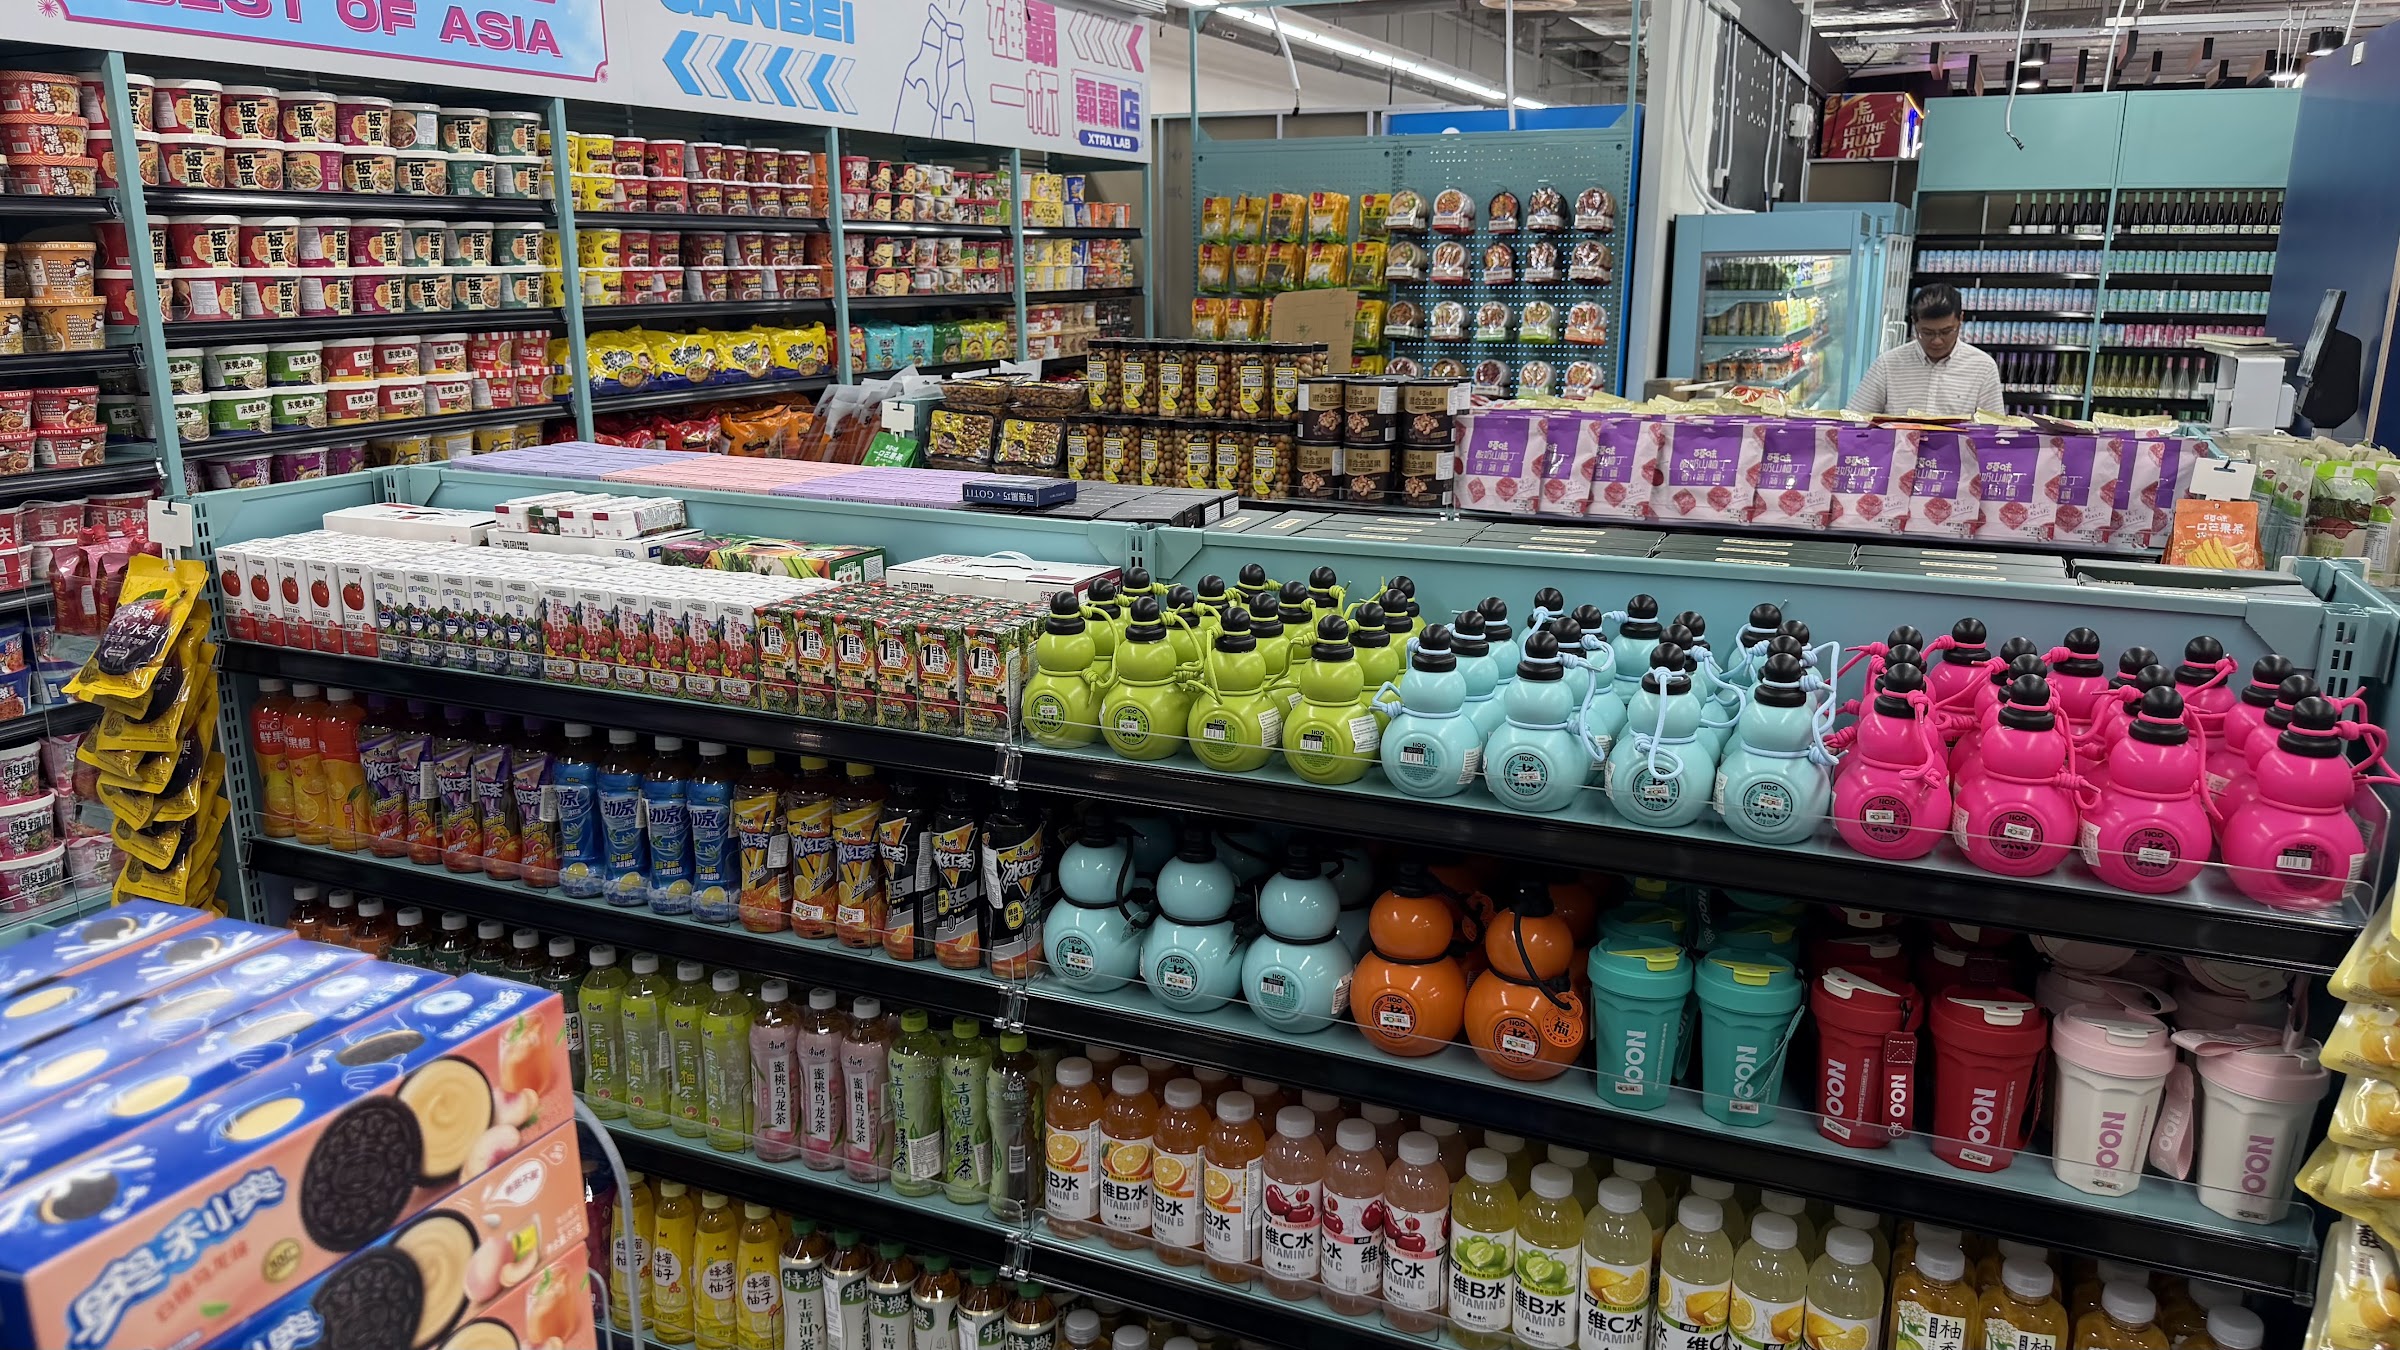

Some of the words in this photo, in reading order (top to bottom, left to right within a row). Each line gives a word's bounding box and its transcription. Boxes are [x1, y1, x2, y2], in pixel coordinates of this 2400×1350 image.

[336, 0, 415, 36] OF
[440, 5, 563, 58] ASIA
[660, 0, 855, 44] NBEI
[194, 96, 210, 130] 板面
[240, 102, 257, 134] 板面
[298, 107, 315, 138] 板面
[1857, 113, 1875, 124] HU
[368, 112, 382, 142] 板面
[457, 121, 473, 148] 板面
[1844, 126, 1866, 138] LET
[1865, 120, 1888, 132] THE
[1088, 133, 1112, 147] XTRA
[1114, 137, 1131, 150] LAB
[1842, 132, 1886, 150] HUAT
[1846, 144, 1880, 159] OUT
[186, 149, 202, 181] 板面
[236, 154, 256, 184] 板面
[357, 162, 373, 191] 板面
[410, 163, 424, 191] 板面
[211, 231, 228, 263] 板面
[266, 233, 282, 263] 板面
[385, 235, 397, 261] 板面
[279, 284, 293, 313] 板面
[421, 281, 437, 307] 板面
[467, 279, 481, 305] 板面
[965, 489, 994, 499] GOTIT
[38, 517, 80, 537] 重庆
[363, 759, 400, 781] 冰红
[794, 837, 834, 857] 冰红茶
[838, 843, 878, 863] 冰红茶
[934, 851, 973, 870] 冰红茶
[1553, 1016, 1570, 1036] 福
[773, 1060, 787, 1125] 蜜桃乌龙茶
[813, 1068, 827, 1133] 蜜桃乌龙茶
[853, 1077, 866, 1143] 蜜桃乌龙茶
[1102, 1179, 1148, 1202] 维B水
[1102, 1195, 1140, 1211] VITAMIN
[1143, 1199, 1149, 1209] B
[1265, 1225, 1314, 1250] 维C水
[1265, 1243, 1305, 1260] VITAMIN
[1307, 1247, 1314, 1257] C
[654, 1267, 675, 1281] 柚子
[709, 1280, 736, 1293] 柚子
[1454, 1273, 1506, 1300] 维B水
[746, 1292, 773, 1305] 柚子
[869, 1294, 909, 1315] 特燃
[1453, 1289, 1498, 1311] VITAMIN
[1499, 1298, 1506, 1308] B
[1514, 1285, 1566, 1317] 维B水
[1514, 1306, 1556, 1327] VITAMIN
[1559, 1317, 1566, 1327] B
[1588, 1308, 1643, 1334] 维C水
[1588, 1326, 1635, 1345] VITAMIN
[1636, 1330, 1643, 1340] C
